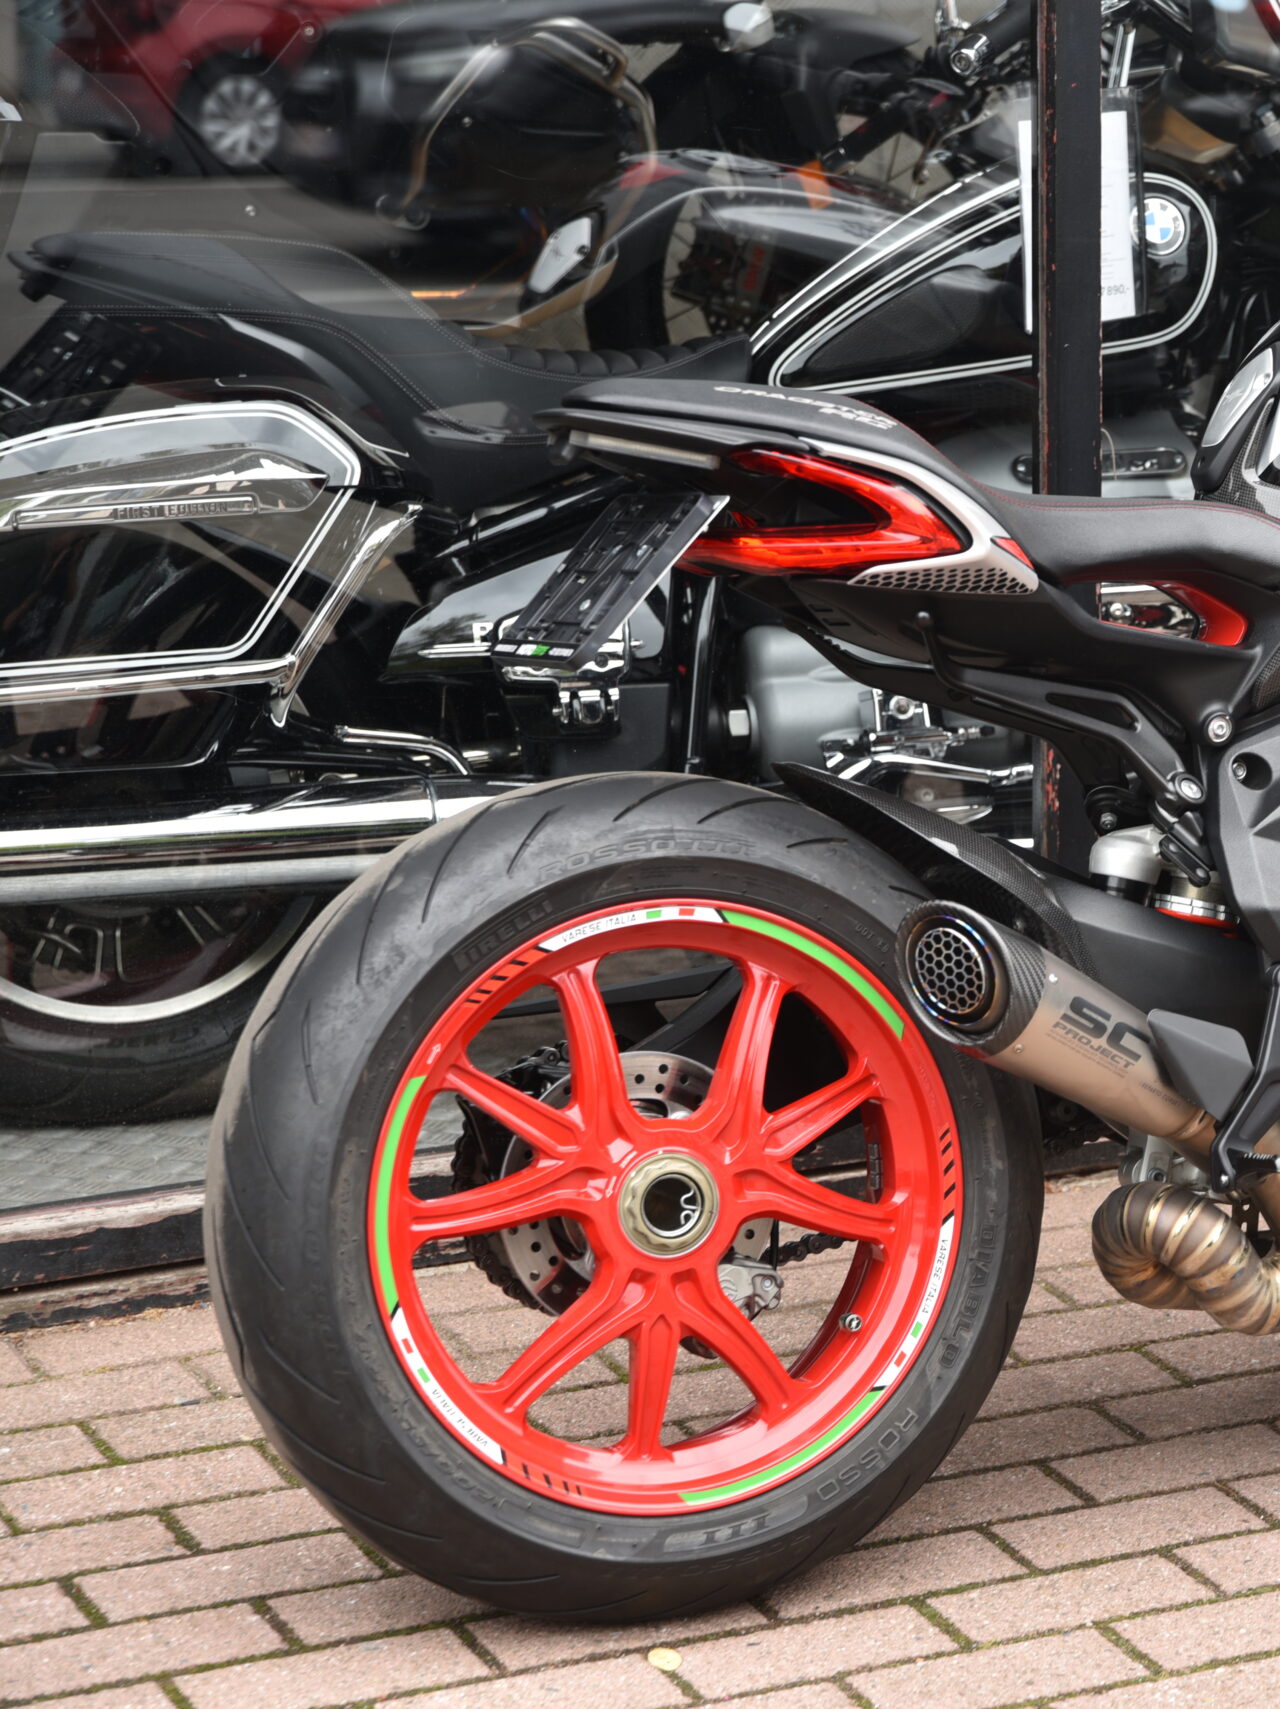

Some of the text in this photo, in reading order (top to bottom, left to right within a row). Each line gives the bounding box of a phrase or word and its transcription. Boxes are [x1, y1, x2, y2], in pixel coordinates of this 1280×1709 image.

[713, 385, 899, 427] DRAGSTER
[115, 502, 230, 521] FIRST EDITION
[538, 838, 675, 883] ROSSO
[452, 892, 554, 973] PIRELLI
[561, 912, 637, 943] VARESE ITALIA
[1052, 1021, 1136, 1070] PROJECT
[1060, 995, 1153, 1063] SC
[921, 1238, 949, 1315] VARESE ITALIA
[938, 1222, 999, 1370] DIABLO
[816, 1407, 919, 1501] ROSSO
[699, 1512, 772, 1546] III
